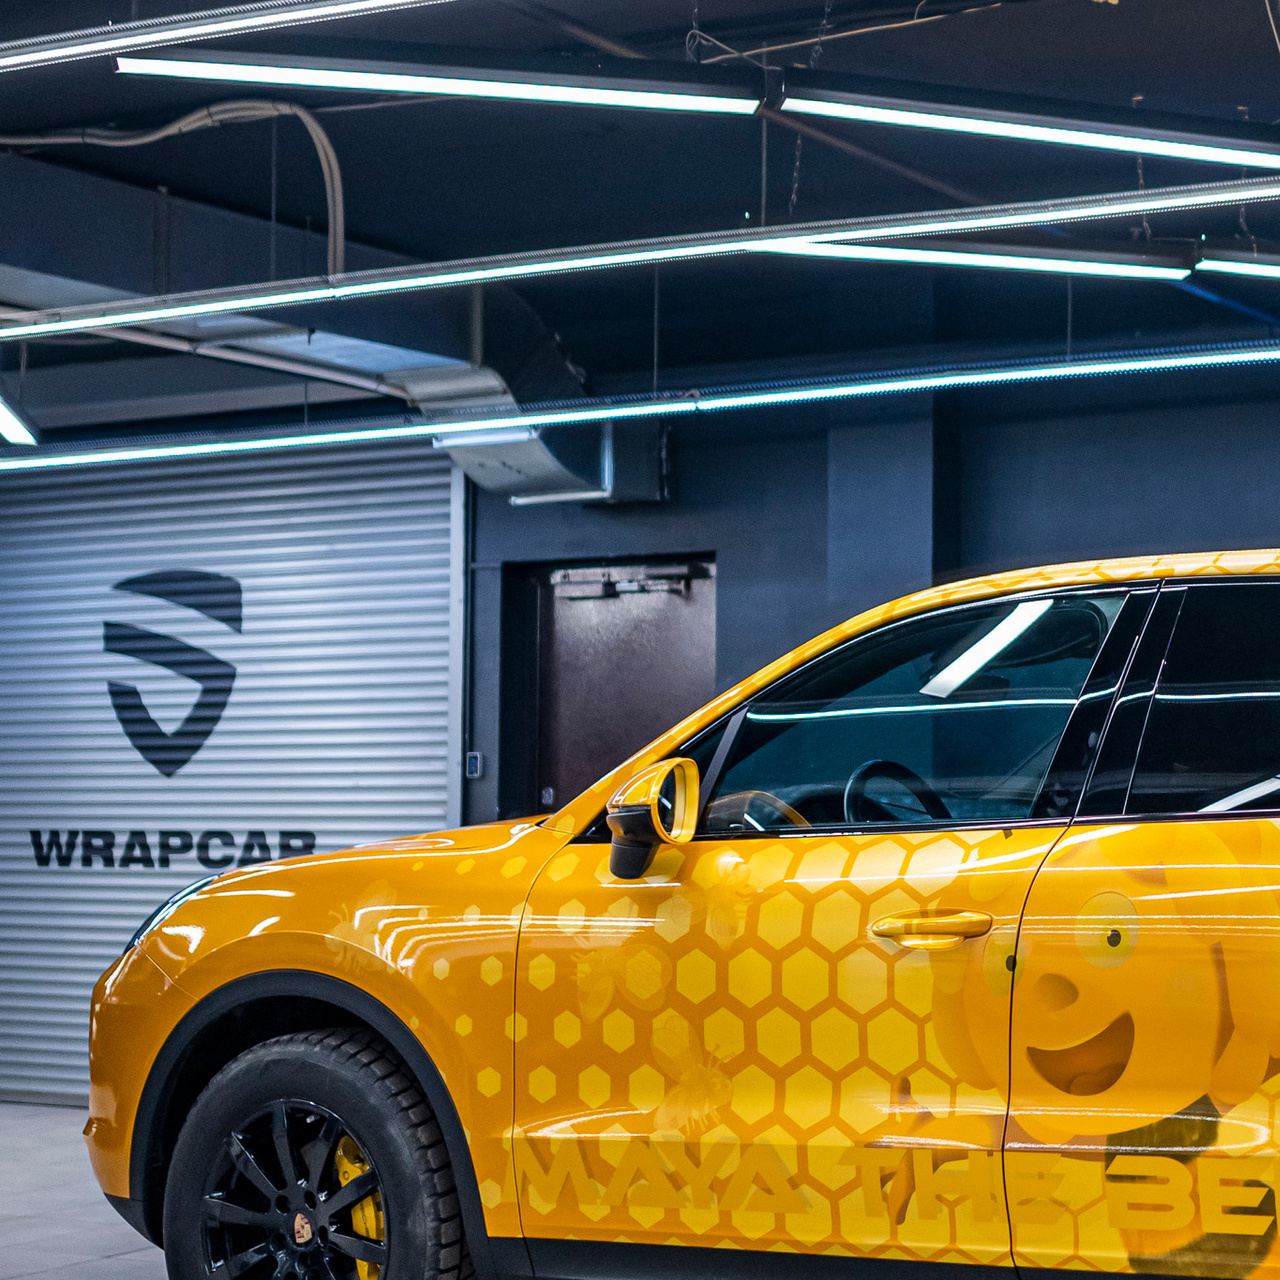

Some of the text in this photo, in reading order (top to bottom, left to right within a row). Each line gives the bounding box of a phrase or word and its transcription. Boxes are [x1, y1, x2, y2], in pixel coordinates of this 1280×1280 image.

[30, 829, 317, 869] WRAPCAR
[500, 1135, 811, 1214] MAYA
[840, 1145, 1068, 1226] THE
